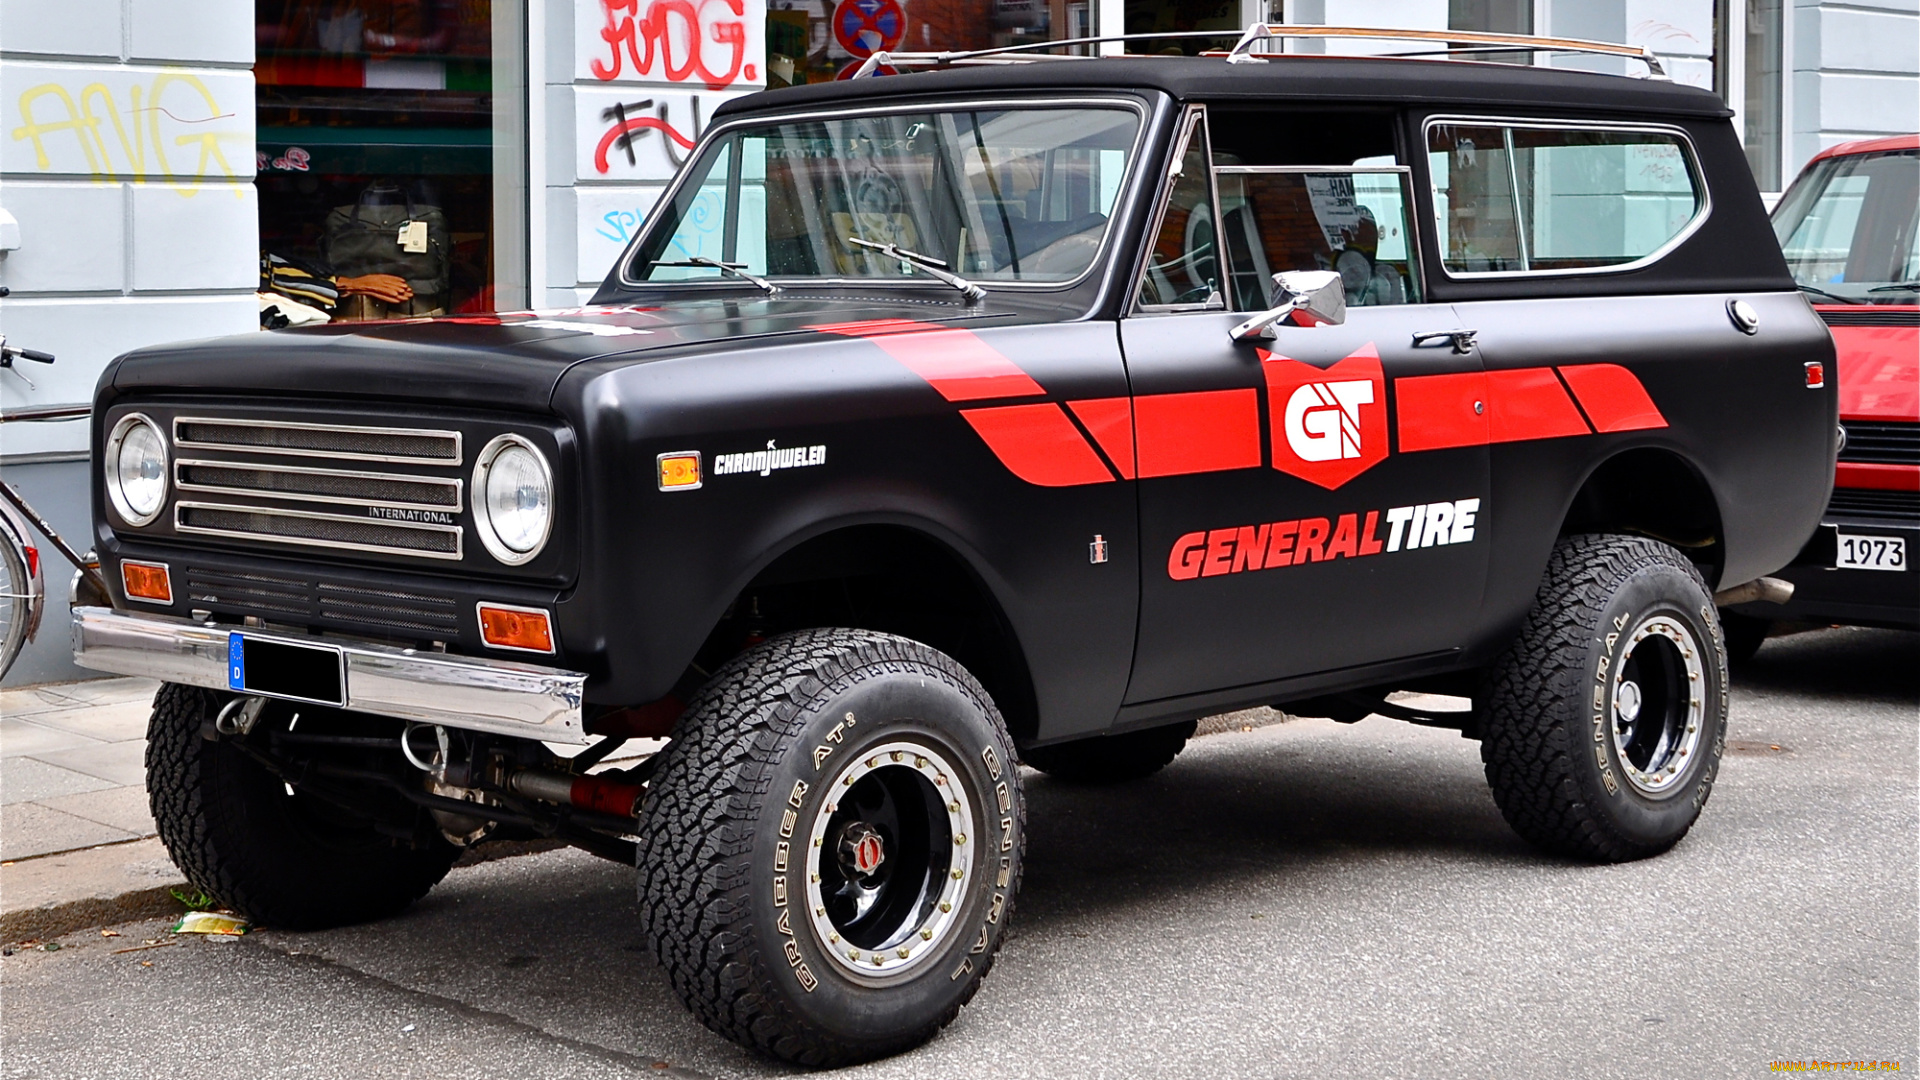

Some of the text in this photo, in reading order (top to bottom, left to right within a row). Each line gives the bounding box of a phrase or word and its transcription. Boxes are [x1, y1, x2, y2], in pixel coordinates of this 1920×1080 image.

[1285, 380, 1374, 462] GT
[369, 507, 453, 523] INTERNATIONAL
[1168, 498, 1480, 581] GENERAL TIRE
[1844, 539, 1903, 566] 1973
[234, 667, 241, 679] D
[1593, 612, 1630, 796] GENERAL
[774, 779, 819, 993] GRABBER
[951, 745, 1014, 981] GENERAL
